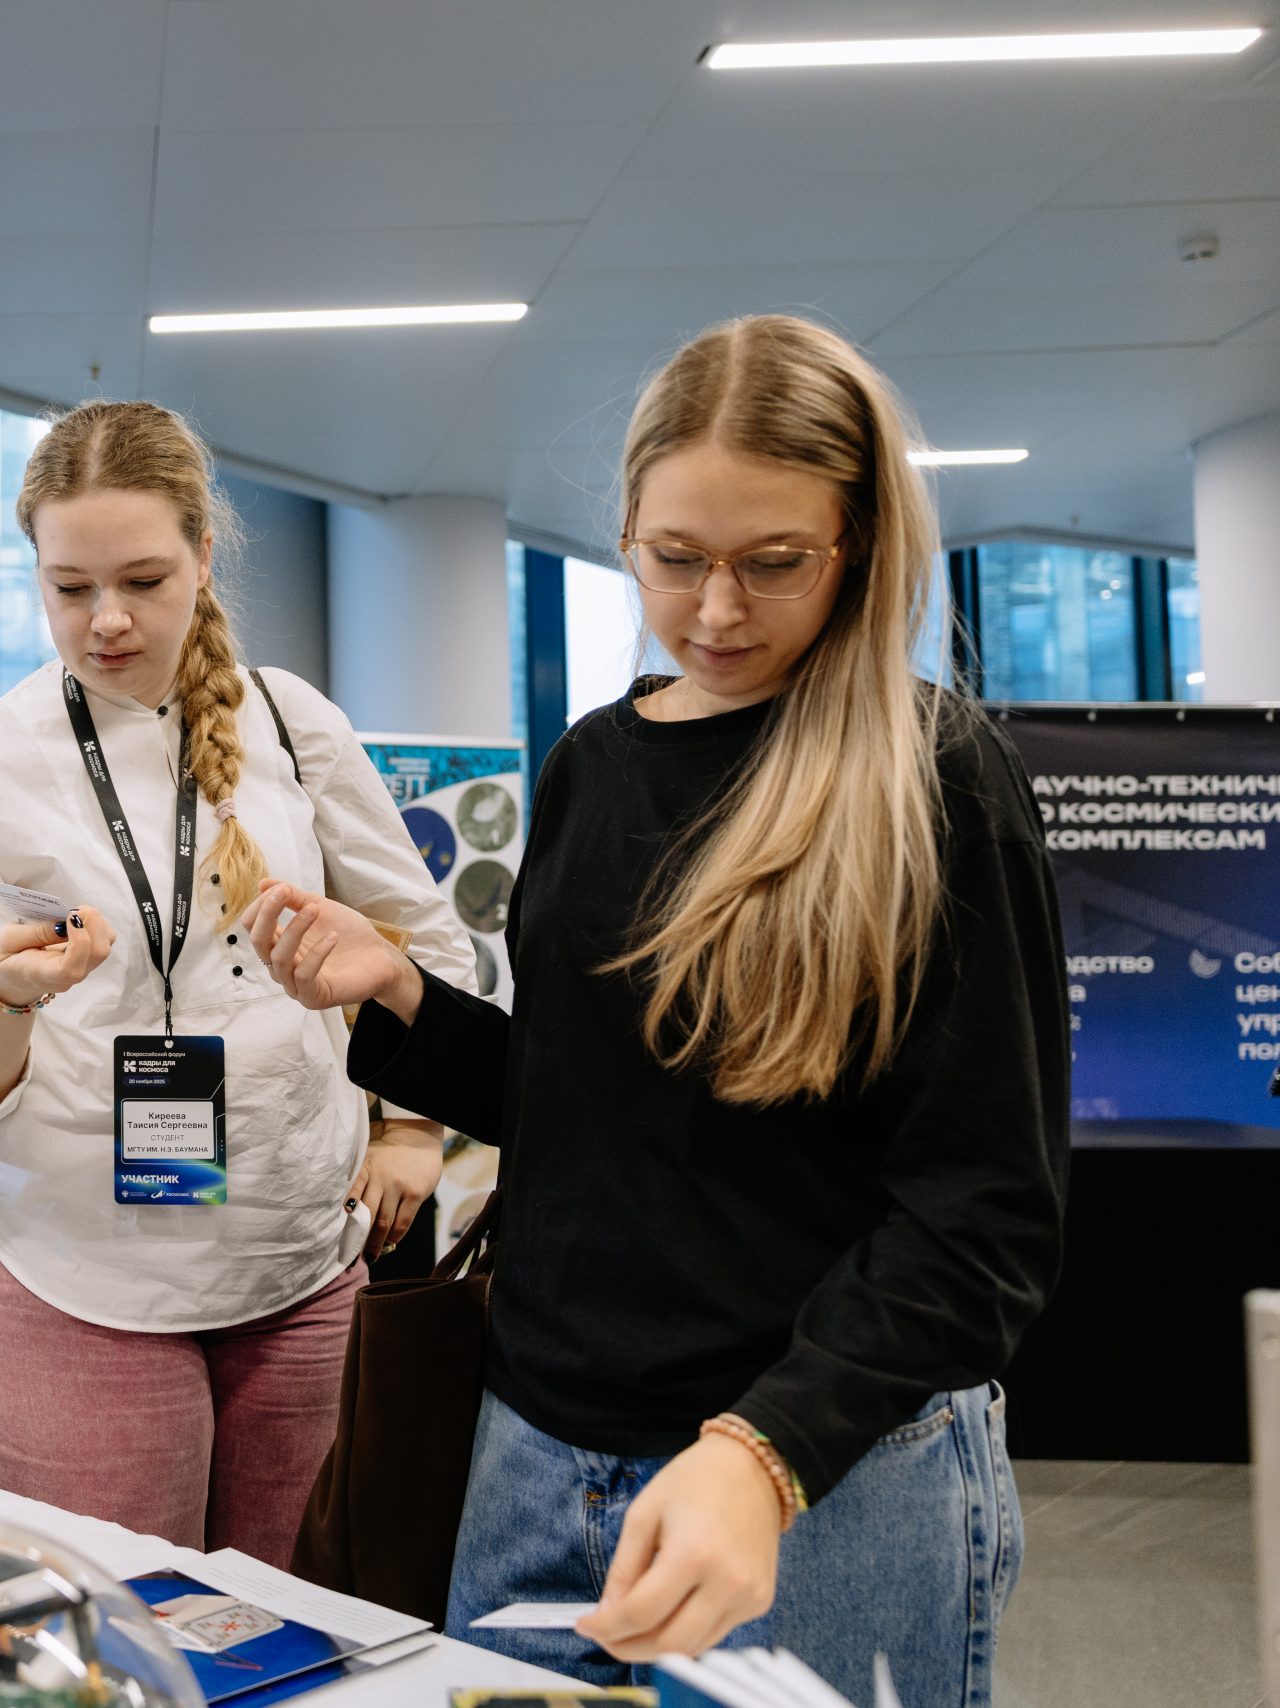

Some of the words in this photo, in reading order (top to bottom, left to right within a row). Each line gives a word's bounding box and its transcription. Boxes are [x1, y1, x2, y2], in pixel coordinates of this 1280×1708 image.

[1029, 774, 1280, 796] АУЧНО-ТЕХНИЧ
[1044, 829, 1266, 850] КОМПЛЕКСАМ
[1066, 955, 1154, 976] дство
[148, 1112, 186, 1121] Киреева
[127, 1121, 159, 1129] Таисия
[160, 1121, 208, 1131] Сергеевна
[150, 1134, 184, 1142] СТУДЕНТ
[121, 1174, 180, 1184] УЧАСТНИК
